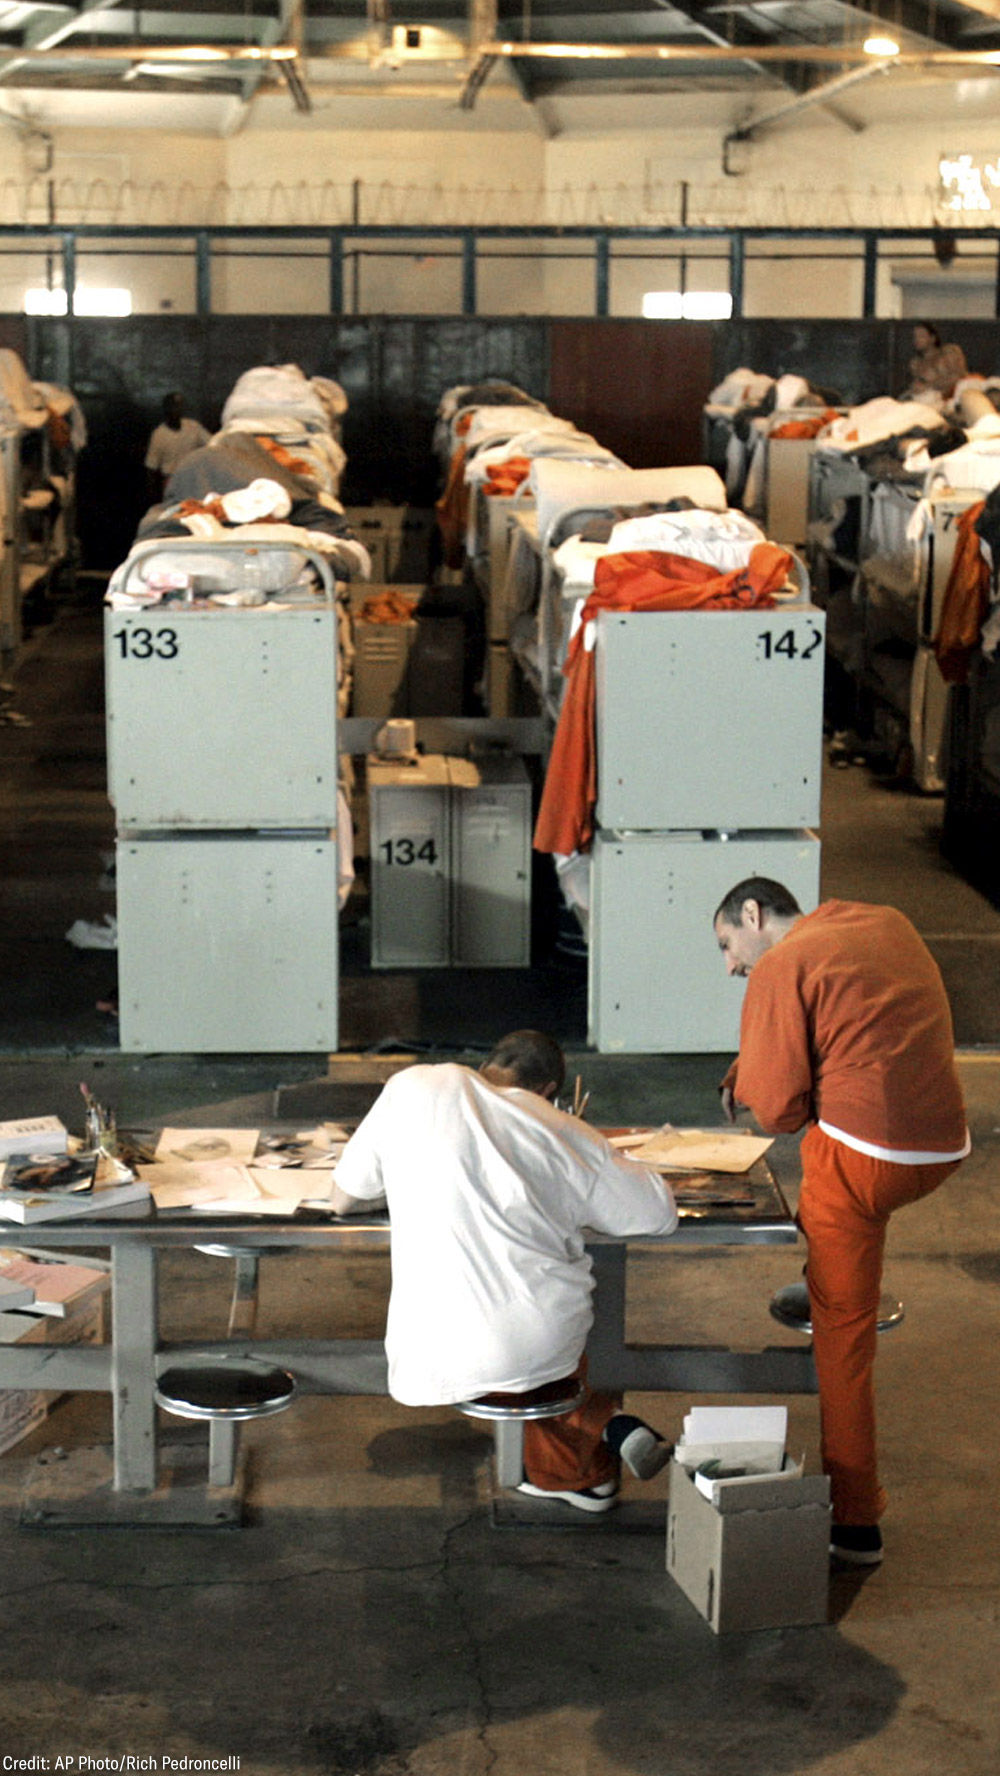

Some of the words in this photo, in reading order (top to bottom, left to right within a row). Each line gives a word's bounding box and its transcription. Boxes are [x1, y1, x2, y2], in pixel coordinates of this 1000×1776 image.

[941, 511, 961, 531] 7
[113, 628, 178, 659] 133
[758, 629, 822, 659] 142
[380, 838, 438, 866] 134
